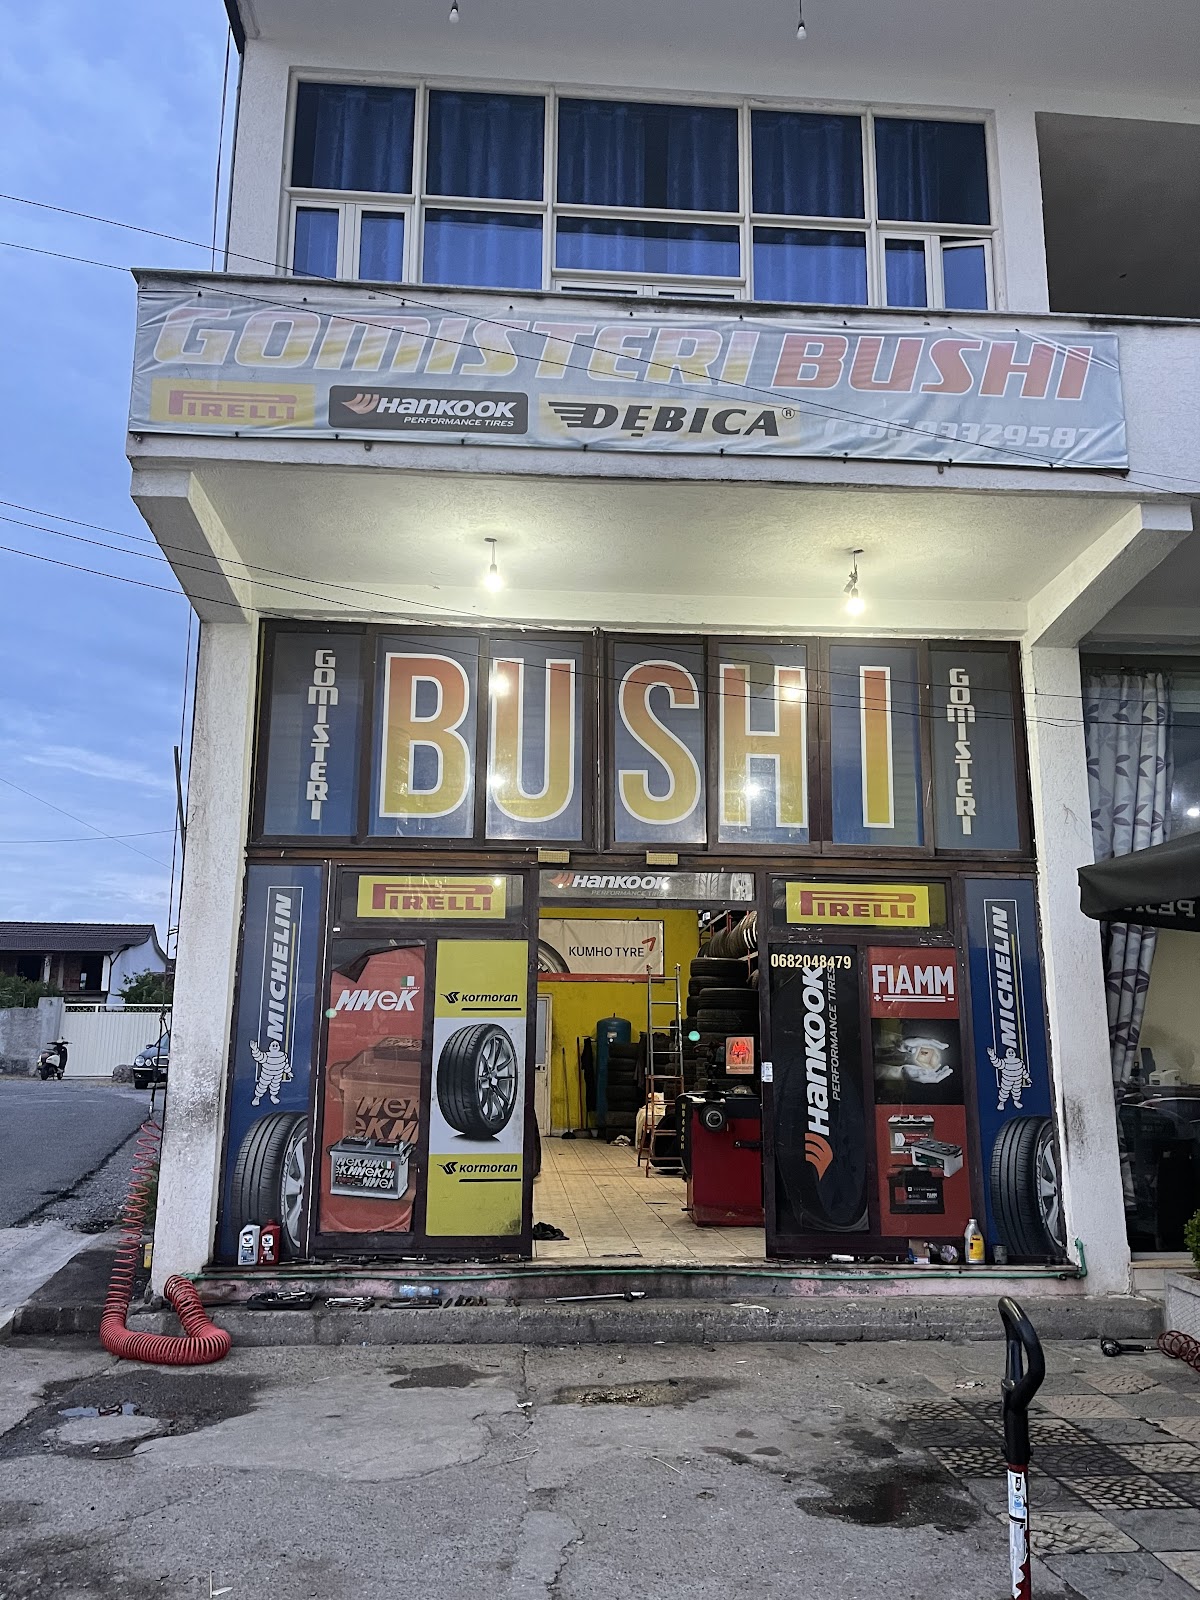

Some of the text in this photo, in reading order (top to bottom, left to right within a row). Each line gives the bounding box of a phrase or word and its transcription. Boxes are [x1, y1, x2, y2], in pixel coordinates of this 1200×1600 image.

[153, 307, 1093, 400] GOMISTERI BUSHI
[169, 390, 297, 419] PIRELLI
[403, 416, 514, 427] PERFORMANCE TIRES
[306, 649, 339, 820] GOMISTERI
[379, 652, 895, 829] BUSHI
[946, 668, 977, 835] GOMISTERI
[372, 884, 494, 911] PIRELLI
[591, 889, 647, 897] PERFORMANCE
[800, 890, 917, 918] PIRELLI
[568, 946, 645, 957] KUMHO TYRE
[770, 953, 852, 969] 0682048479
[266, 893, 292, 1042] MICHELIN
[871, 964, 955, 995] FIAMM
[992, 906, 1017, 1049] MICHELIN
[827, 965, 841, 1101] PERFORMANCE TIRES
